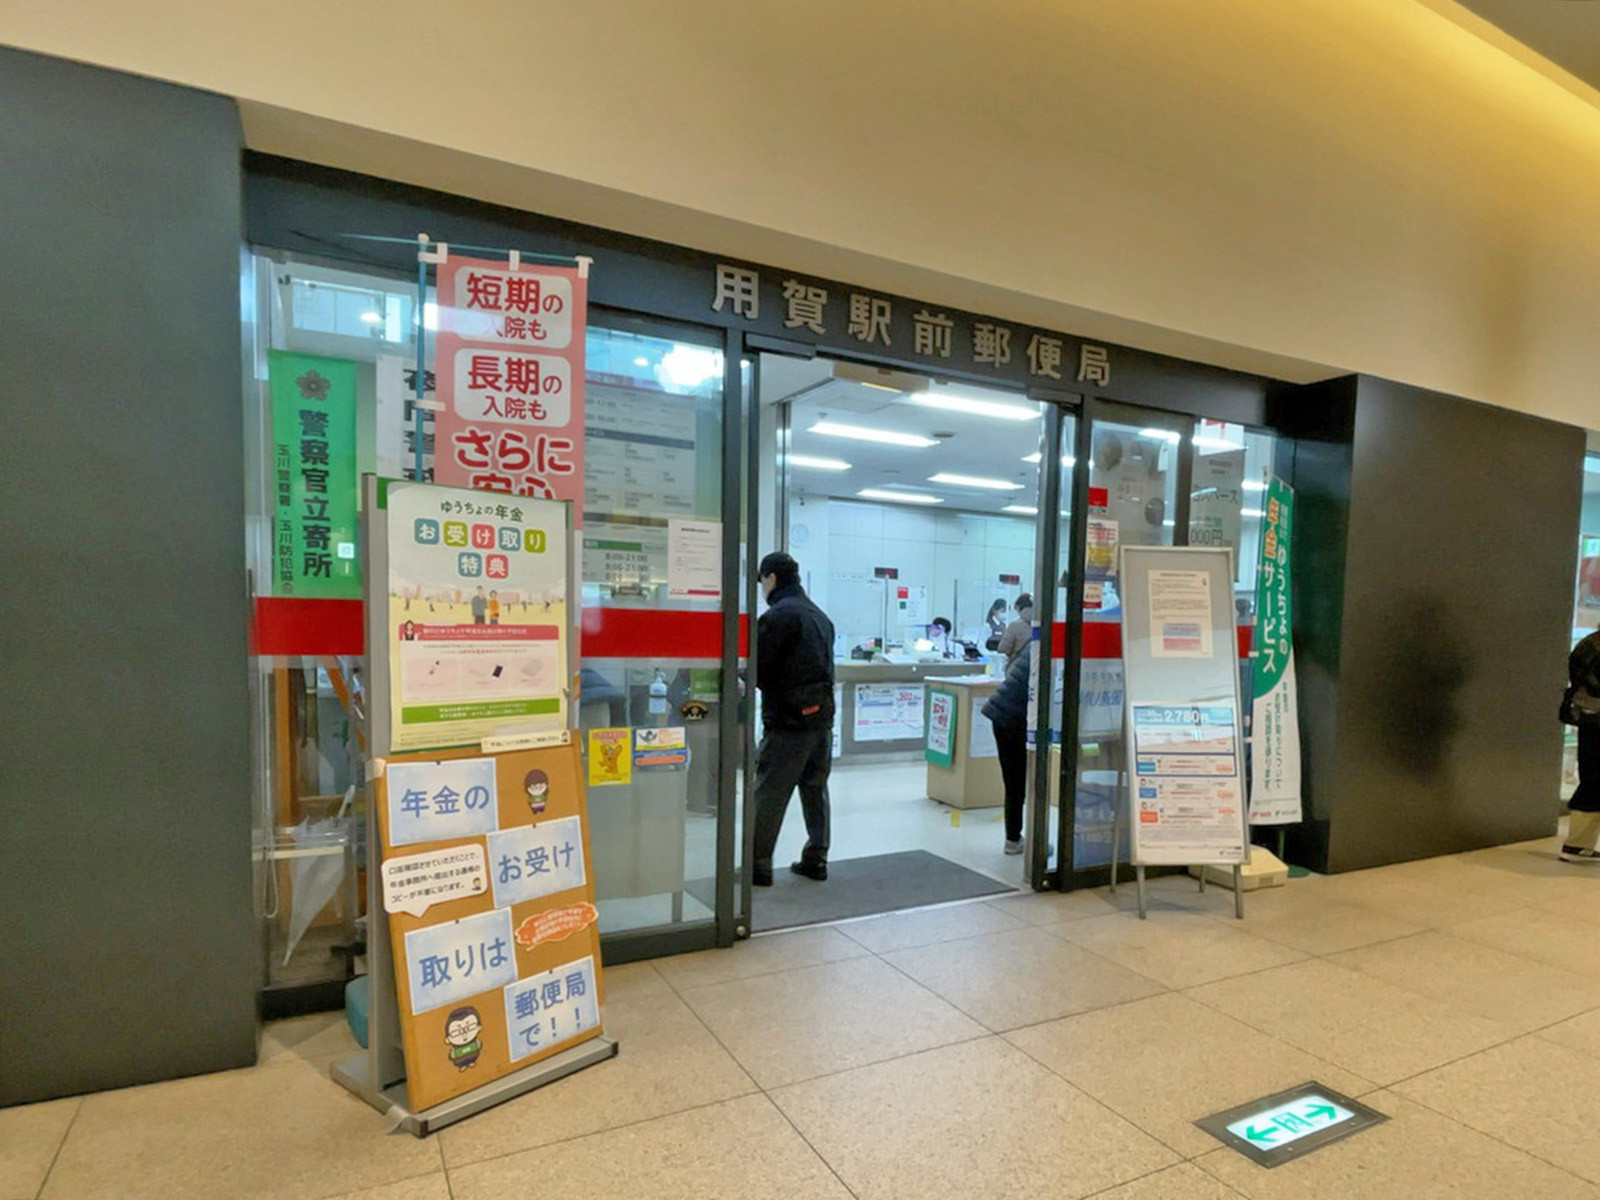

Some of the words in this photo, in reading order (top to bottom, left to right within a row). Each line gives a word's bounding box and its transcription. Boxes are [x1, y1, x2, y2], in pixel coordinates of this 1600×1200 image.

[466, 272, 563, 315] 短期の
[712, 264, 1111, 387] 用賀駅前郵便局
[467, 356, 563, 395] 長期の
[482, 396, 547, 421] 入院も
[456, 429, 572, 473] さらに
[299, 410, 332, 578] 警察官立寄所
[441, 501, 524, 522] ゆうちょの年金
[418, 522, 542, 549] お受け取り
[461, 556, 507, 577] 特典
[1263, 497, 1279, 673] 年金サービス
[401, 786, 489, 818] 年金の
[498, 842, 575, 883] お受け
[419, 937, 509, 989] 取りは
[514, 971, 586, 1021] 郵便局
